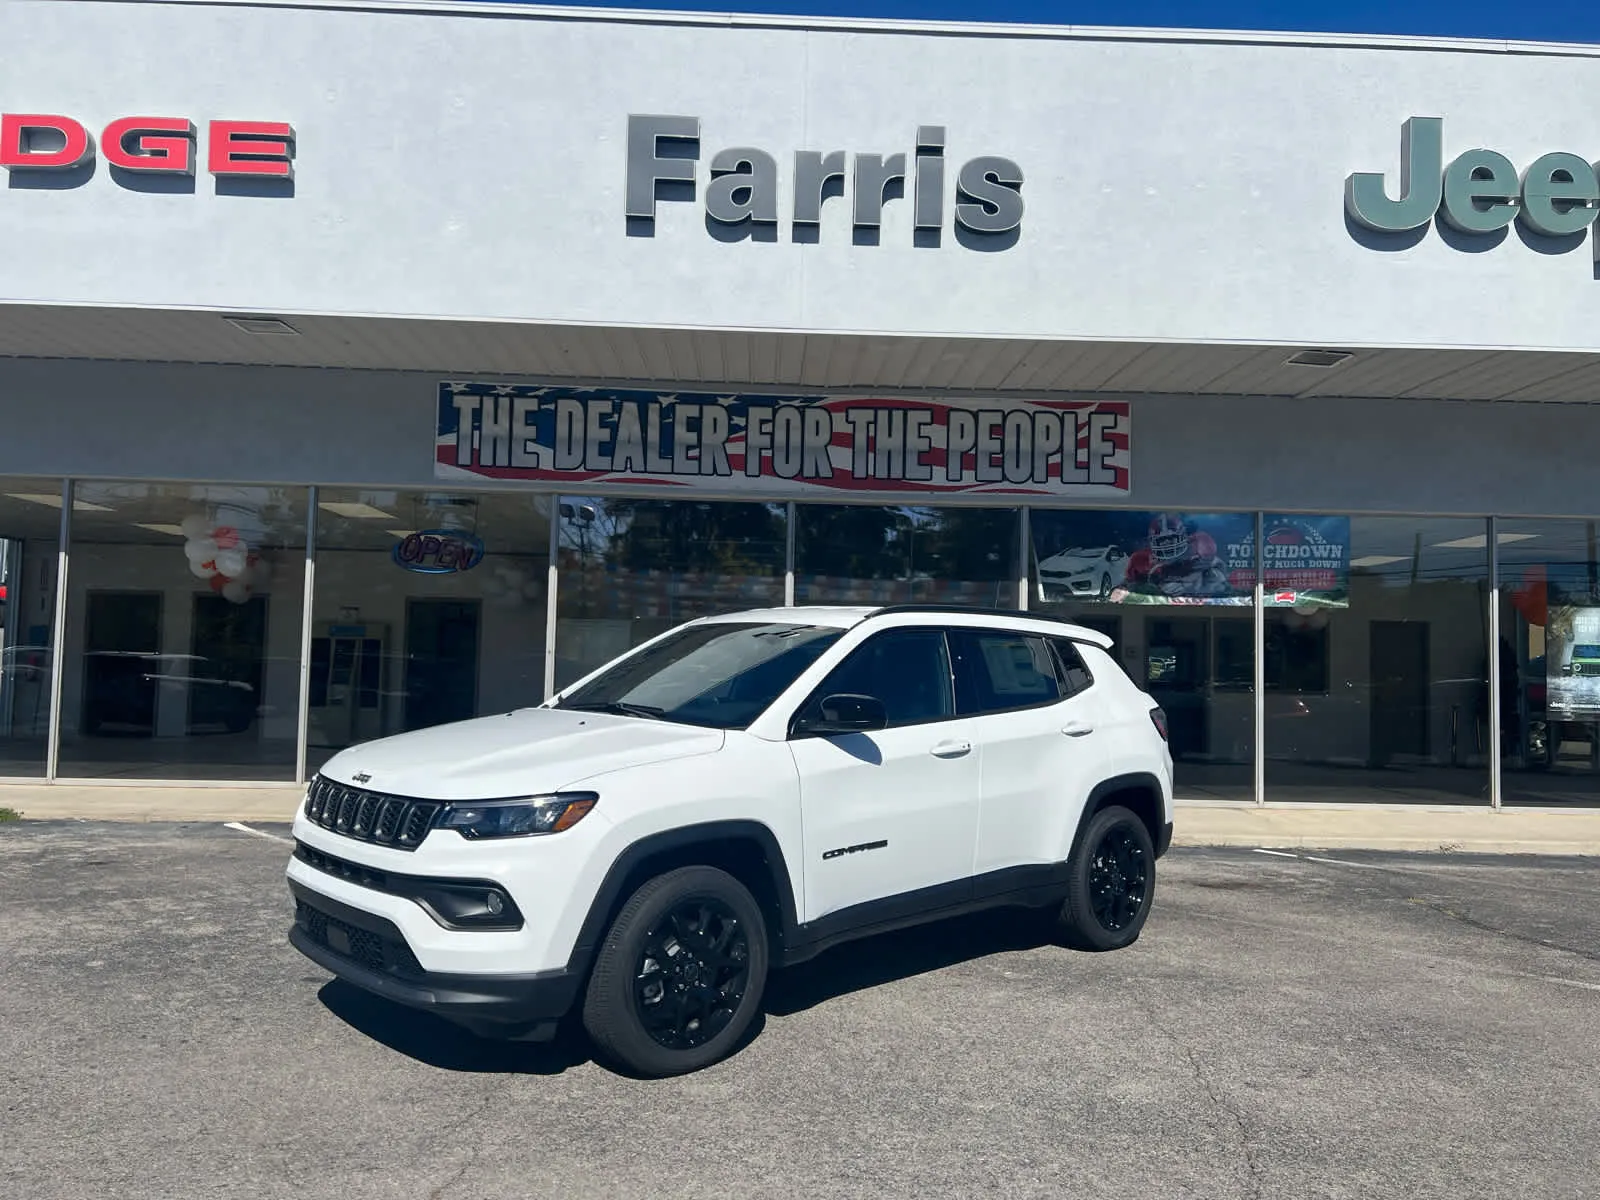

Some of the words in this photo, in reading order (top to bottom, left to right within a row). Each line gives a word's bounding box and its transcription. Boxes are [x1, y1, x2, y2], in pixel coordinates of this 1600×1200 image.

[625, 113, 1026, 236] Farris
[1344, 116, 1600, 260] Jee
[452, 394, 540, 469] THE
[553, 398, 733, 477] DEALER
[744, 403, 834, 481] FOR
[846, 406, 934, 482] THE
[946, 408, 1118, 486] PEOPLE
[399, 533, 475, 571] OPEN
[1227, 543, 1343, 559] TOCHDOWN
[1228, 559, 1249, 568] FOR
[1275, 560, 1305, 569] MUCH
